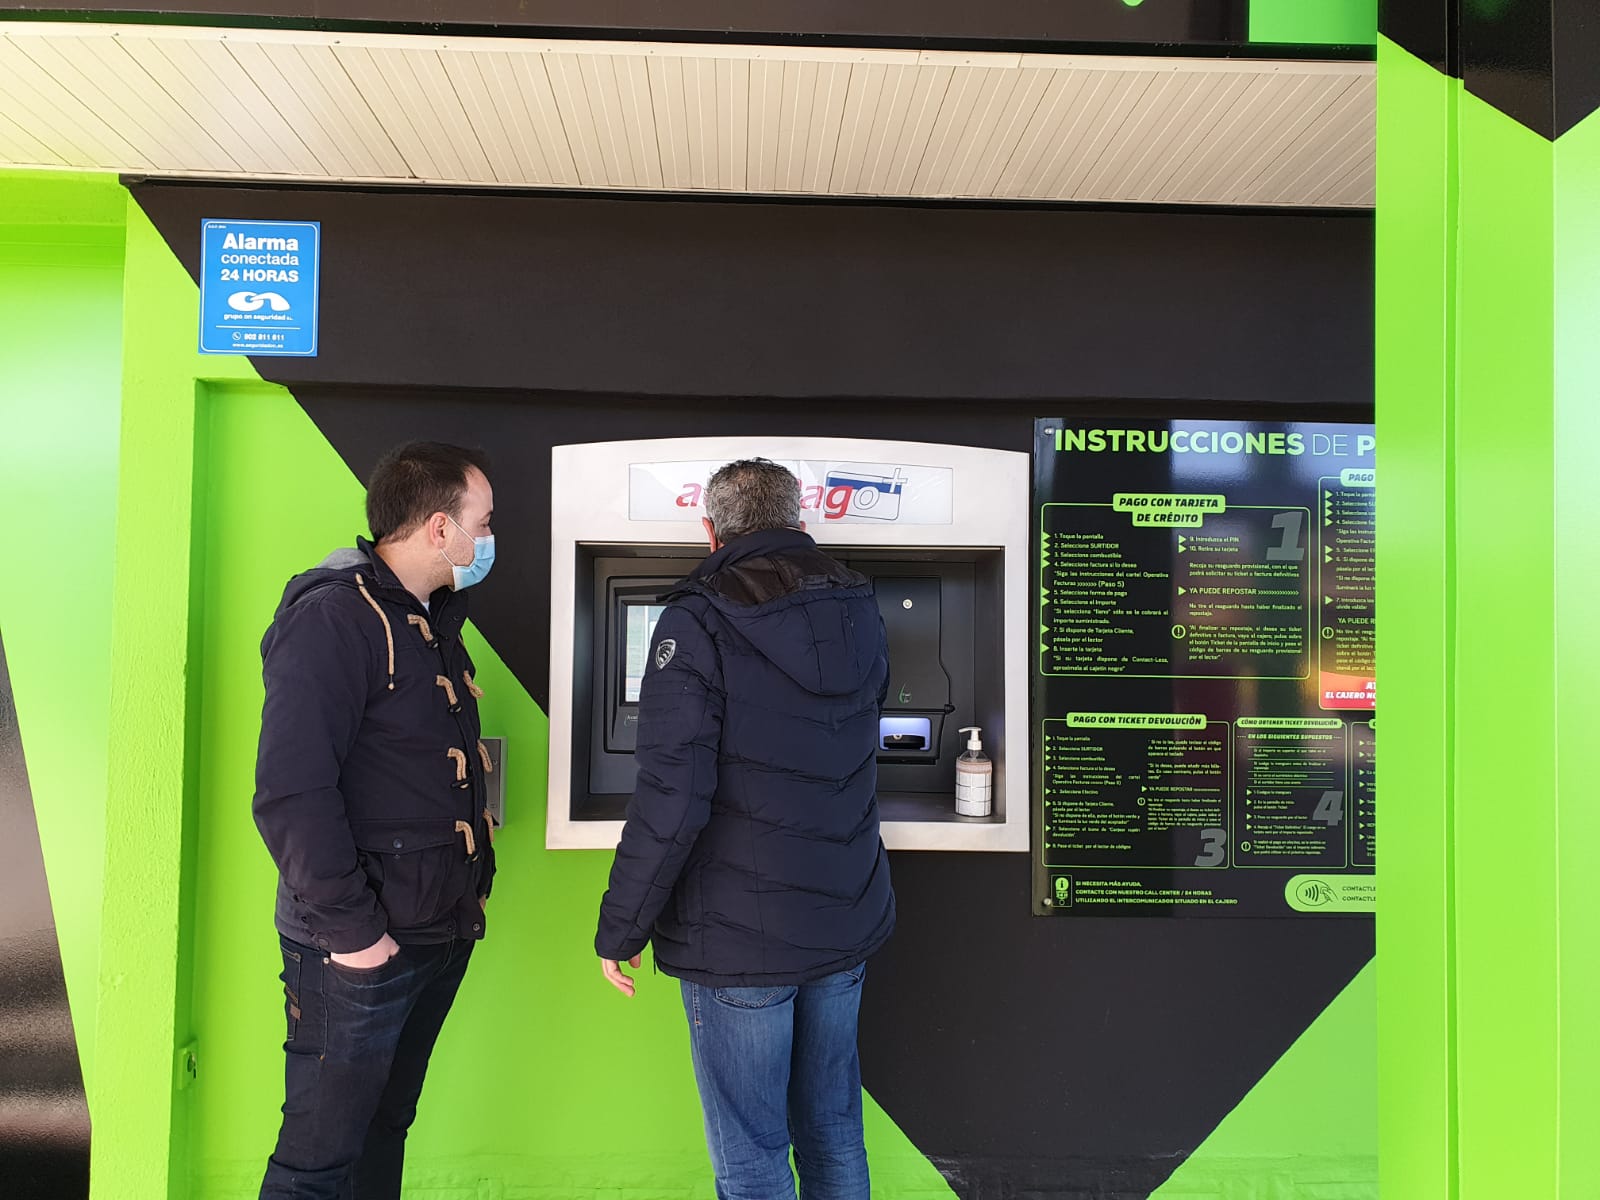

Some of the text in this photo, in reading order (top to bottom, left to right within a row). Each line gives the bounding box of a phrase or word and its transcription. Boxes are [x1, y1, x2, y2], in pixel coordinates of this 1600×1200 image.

[223, 233, 298, 250] Alarma
[221, 253, 299, 265] conectada
[221, 269, 298, 282] 24 HORAS
[1055, 430, 1304, 456] INSTRUCCIONES
[1312, 434, 1349, 456] DE
[1119, 497, 1218, 508] PAGO CON TARJETA
[1137, 512, 1198, 523] DE CRÉDITO
[1266, 511, 1304, 560] 1
[1149, 716, 1201, 725] DEVOLUCIÓN
[1312, 791, 1343, 826] 4
[1194, 828, 1226, 866] 3
